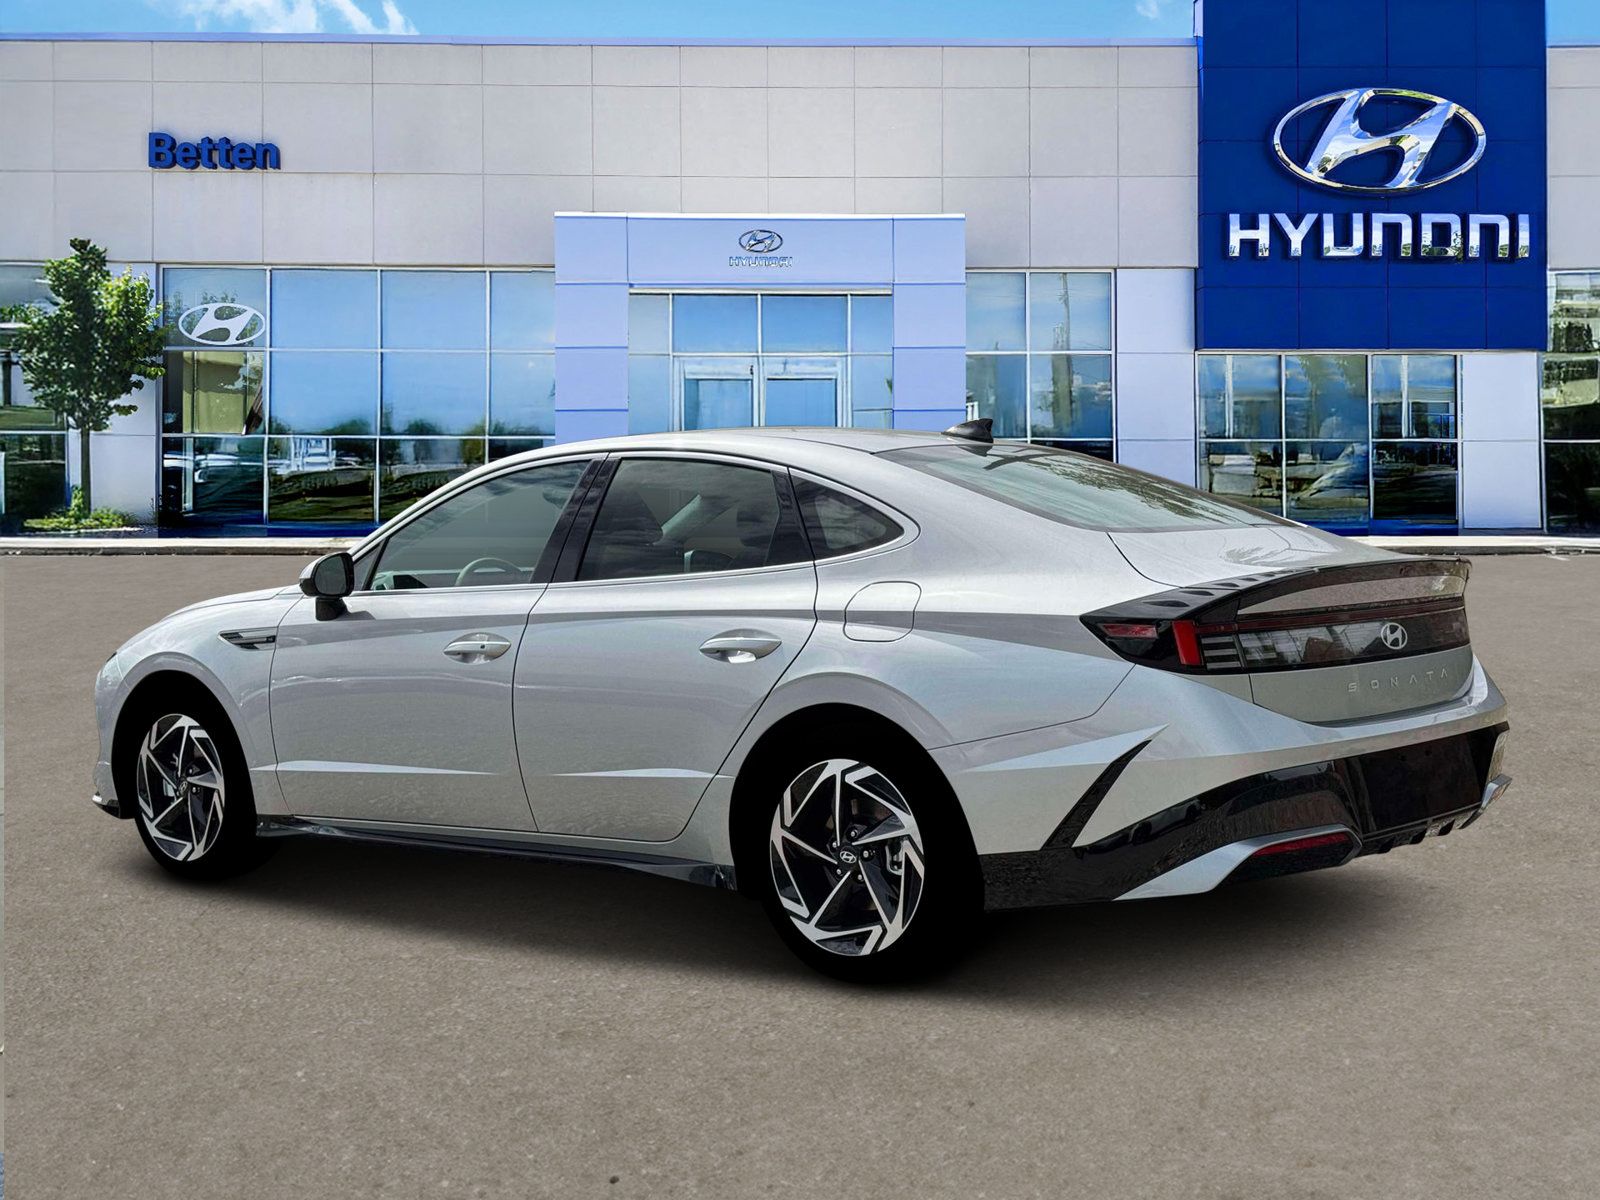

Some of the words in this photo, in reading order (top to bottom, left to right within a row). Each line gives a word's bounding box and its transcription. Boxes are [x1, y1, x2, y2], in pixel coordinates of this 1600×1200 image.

[148, 132, 280, 170] Betten
[1228, 213, 1530, 258] HYUNDAI
[729, 256, 792, 267] HYUNDAI
[1347, 667, 1449, 693] SONATA
